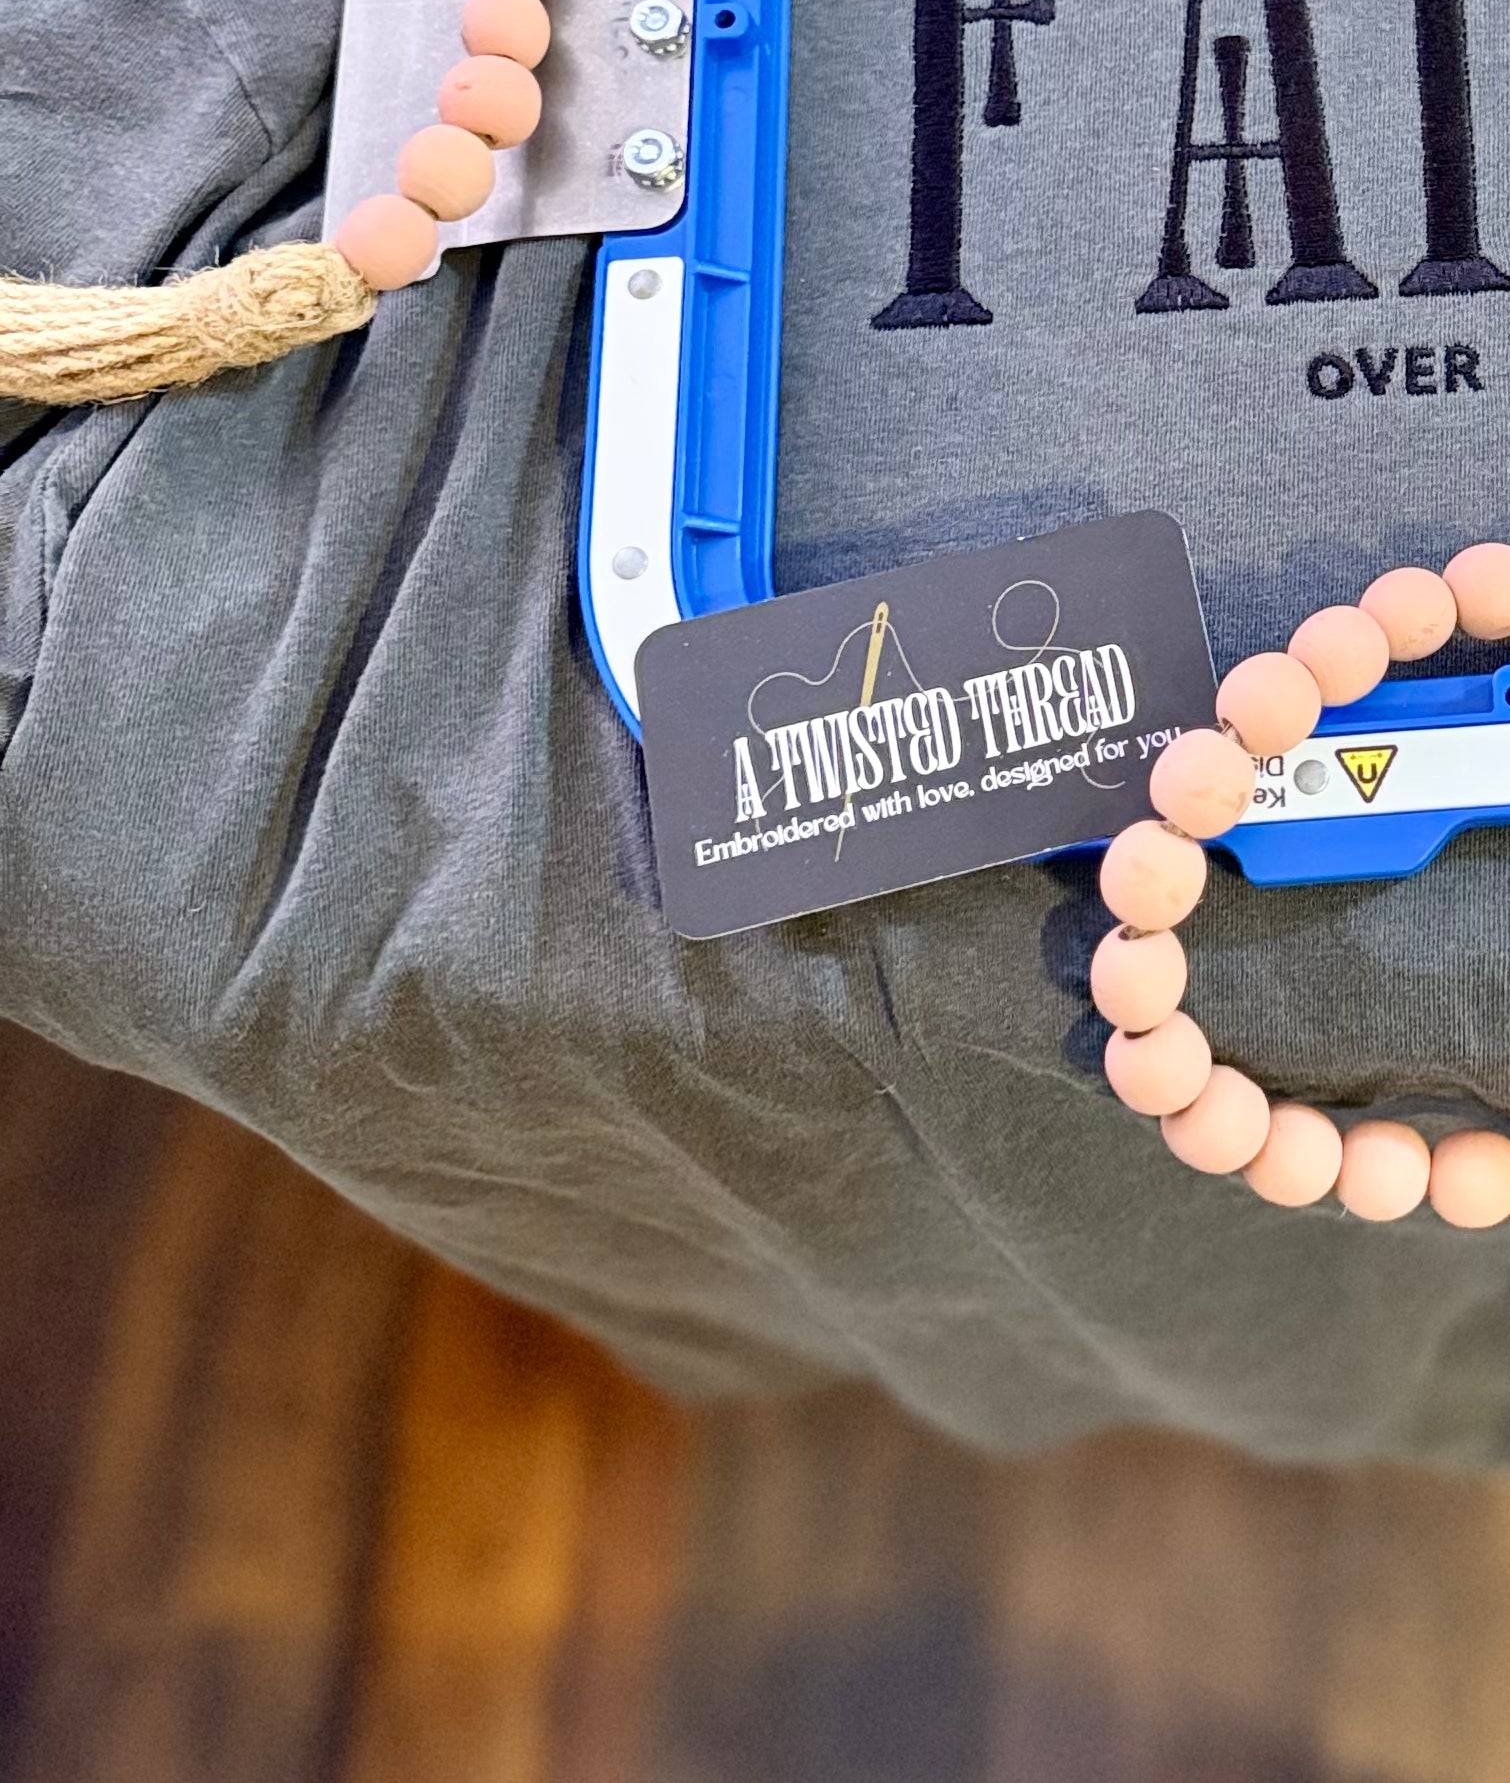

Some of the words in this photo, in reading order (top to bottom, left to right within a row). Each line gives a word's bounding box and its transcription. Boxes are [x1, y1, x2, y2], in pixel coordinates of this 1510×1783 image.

[1306, 331, 1484, 400] OVER
[734, 736, 768, 824] A
[764, 686, 963, 811] TWISTED
[963, 643, 1136, 759] THREAD
[694, 802, 857, 867] Embroidered
[861, 790, 913, 823] with
[980, 742, 1091, 791] designed
[1094, 737, 1129, 764] for
